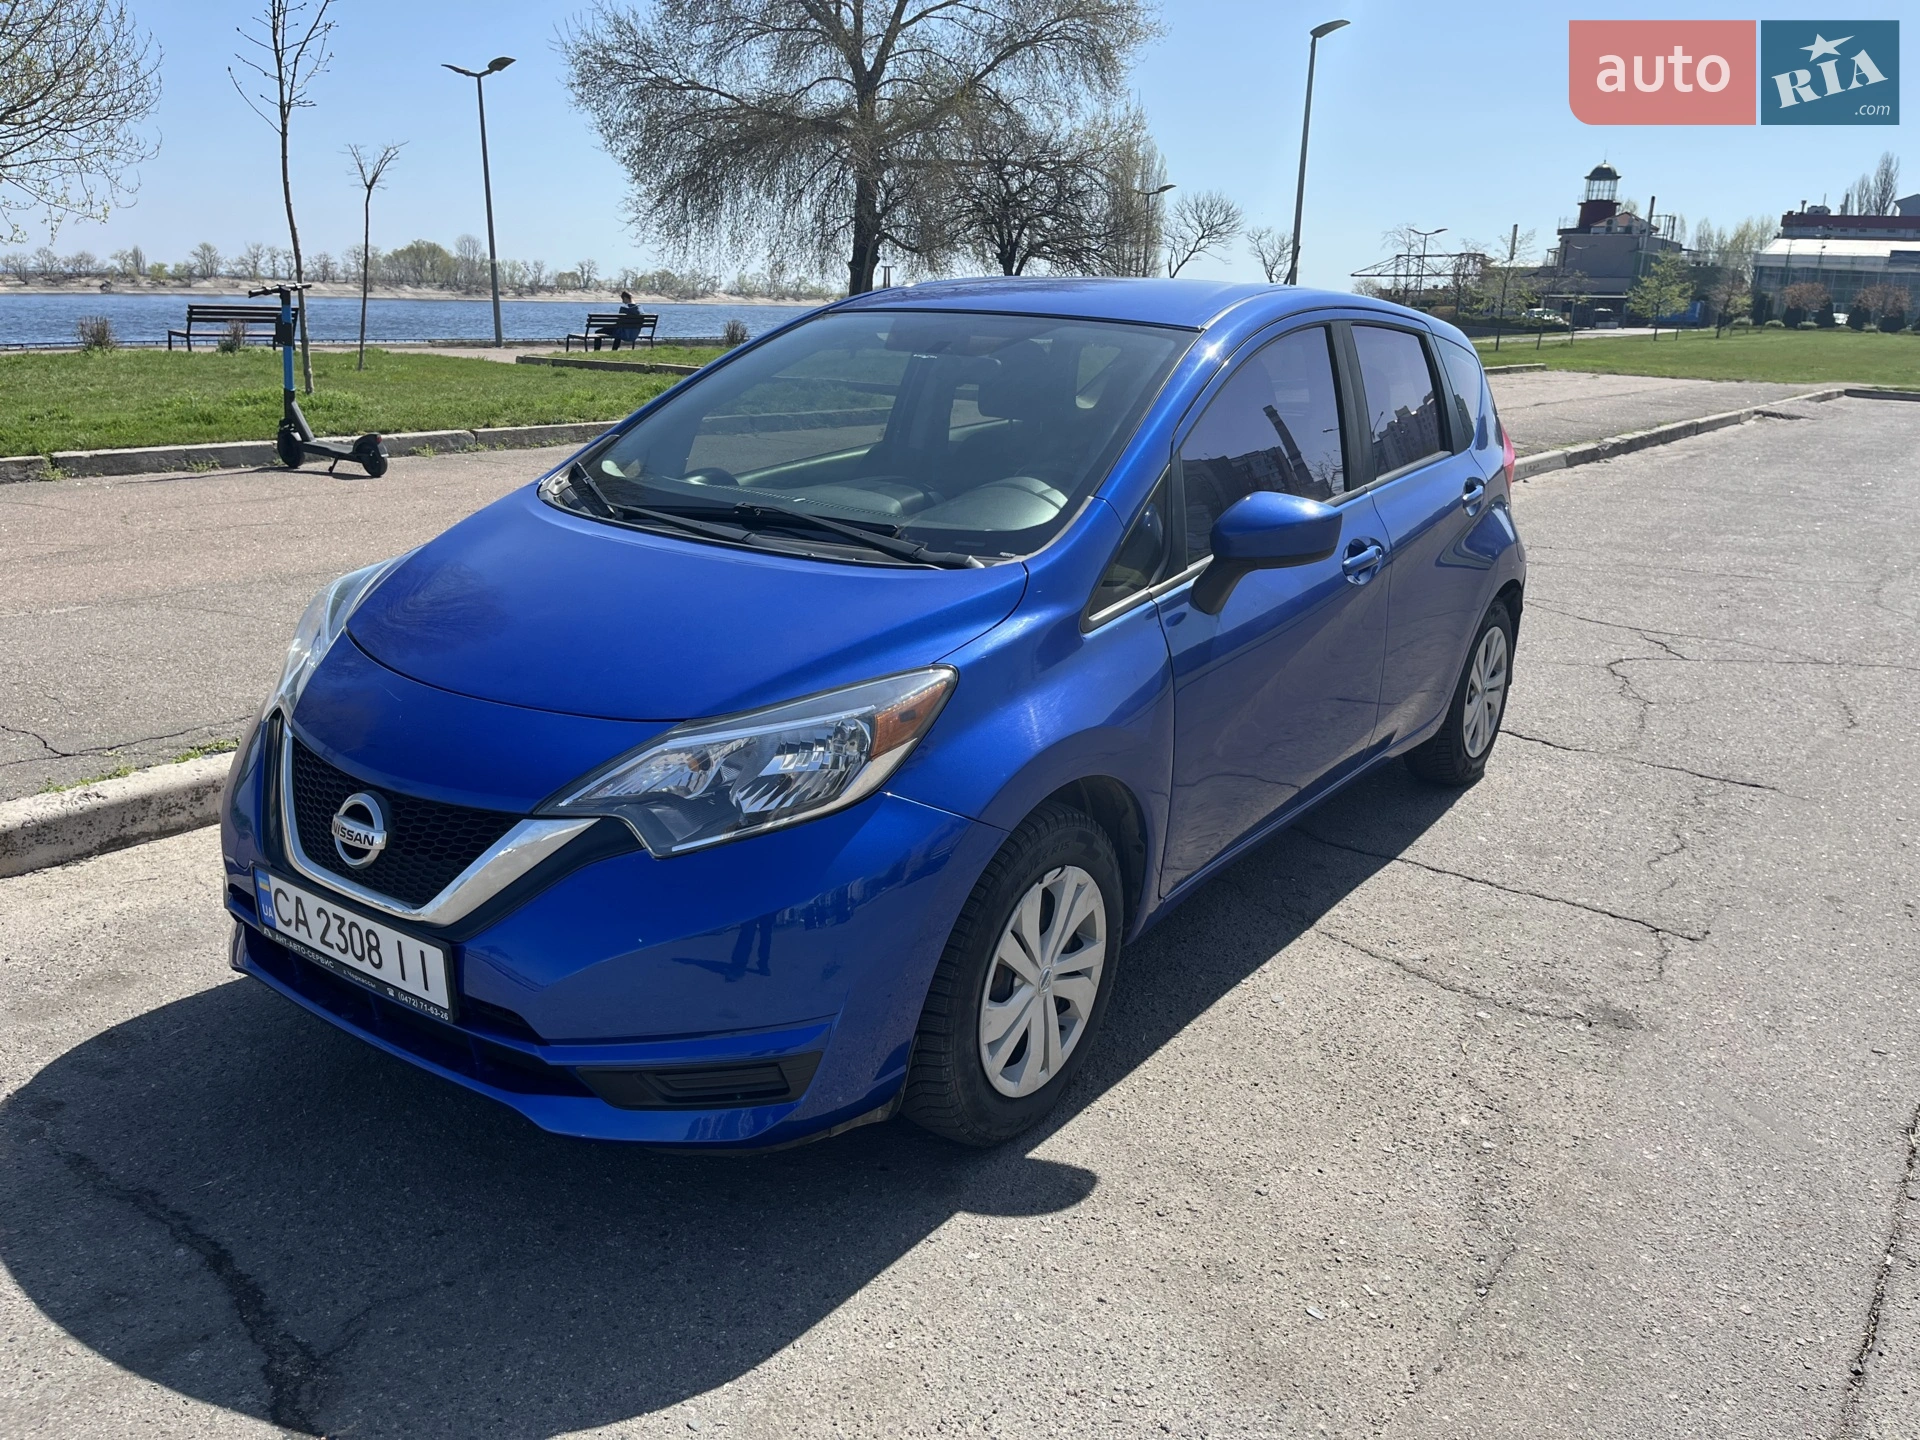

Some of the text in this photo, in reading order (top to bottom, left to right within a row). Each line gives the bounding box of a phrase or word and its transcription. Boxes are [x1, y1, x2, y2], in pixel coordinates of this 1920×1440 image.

[333, 820, 375, 847] NISSAN
[261, 903, 274, 919] UA
[273, 887, 313, 940] CA
[316, 907, 383, 970] 2308
[397, 991, 418, 1008] (0472)
